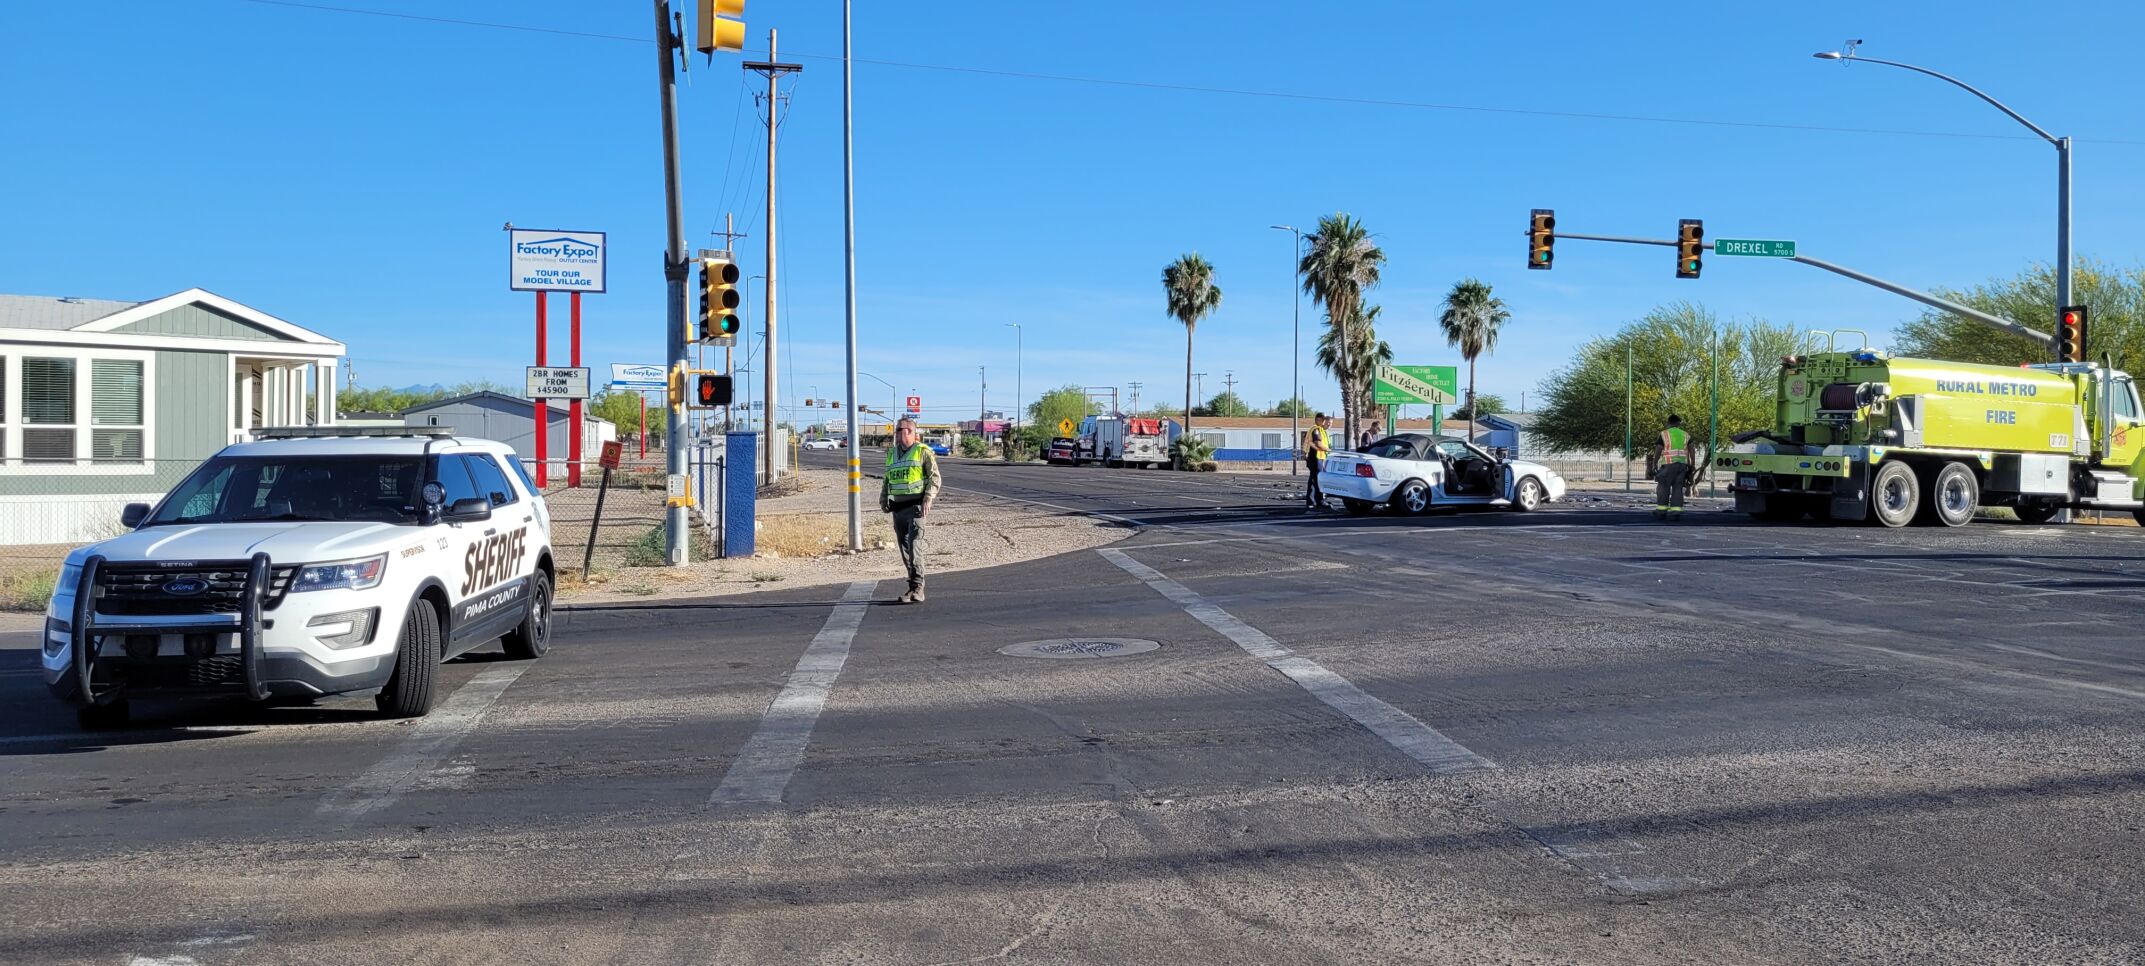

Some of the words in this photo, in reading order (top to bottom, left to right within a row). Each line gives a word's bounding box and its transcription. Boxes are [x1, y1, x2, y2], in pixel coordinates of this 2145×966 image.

[517, 242, 561, 257] Factory
[563, 244, 594, 258] Expo
[1726, 242, 1768, 254] DREXEL
[523, 277, 554, 285] MODEL
[533, 370, 548, 378] 2BR
[553, 370, 579, 378] HOMES
[1381, 366, 1442, 403] Fitzgerald
[1936, 380, 1984, 394] RURAL
[1988, 382, 2037, 396] METRO
[1986, 409, 2016, 424] FIRE
[889, 469, 909, 481] HERIFF
[437, 536, 449, 550] 123
[461, 526, 527, 597] SHERIFF
[171, 583, 196, 591] Ford
[464, 599, 487, 620] PIMA
[488, 585, 521, 609] COUNTY
